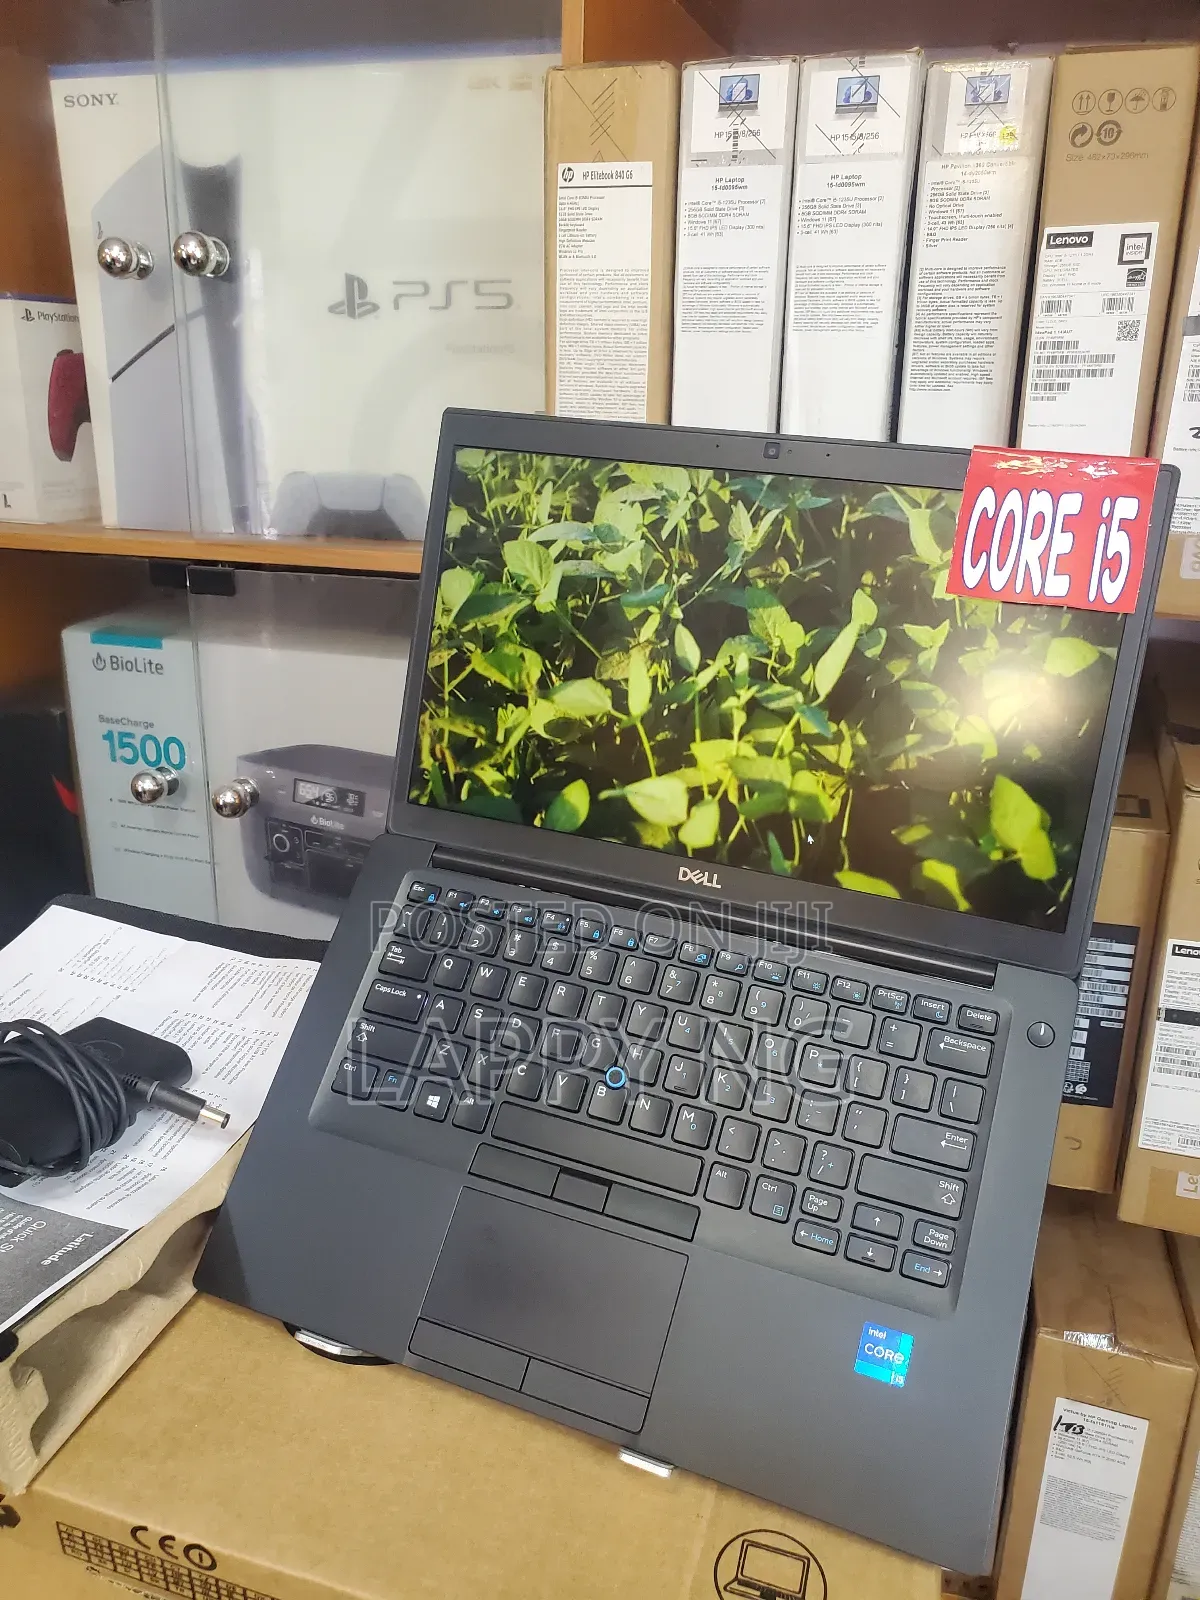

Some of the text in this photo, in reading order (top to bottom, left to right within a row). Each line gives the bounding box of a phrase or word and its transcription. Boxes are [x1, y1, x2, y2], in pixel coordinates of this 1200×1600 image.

[64, 93, 117, 109] SONY
[582, 170, 633, 180] HP Elitebook 840 G6
[1050, 235, 1089, 245] Lenovo
[1126, 242, 1144, 251] intel
[392, 280, 514, 311] PS5
[38, 311, 79, 324] PlayStation
[962, 485, 1140, 605] CORE i5
[110, 655, 164, 676] BioLite
[98, 714, 155, 729] BaseCharge
[101, 729, 186, 771] 1500
[678, 867, 721, 888] DELL
[413, 884, 425, 892] Esc
[448, 891, 457, 899] F1
[480, 898, 490, 906] F2
[546, 913, 555, 921] F4
[580, 920, 589, 928] F5
[613, 928, 623, 936] F6
[648, 936, 658, 944] F7
[390, 945, 403, 954] Tab
[444, 959, 453, 970] Q
[547, 957, 555, 966] 4
[758, 961, 773, 970] F10
[480, 967, 493, 978] W
[585, 966, 593, 975] 5
[798, 970, 810, 979] F11
[519, 976, 527, 987] E
[625, 975, 632, 984] 6
[837, 980, 851, 989] F12
[375, 983, 407, 997] Caps Lock
[557, 986, 566, 996] R
[878, 989, 905, 1000] PrtScr
[436, 999, 445, 1009] A
[598, 995, 606, 1005] T
[707, 995, 715, 1004] 8
[637, 1005, 647, 1015] Y
[750, 1006, 758, 1014] 9
[920, 999, 945, 1011] Insert
[474, 1009, 483, 1018] S
[966, 1010, 992, 1022] Delete
[512, 1018, 521, 1028] D
[678, 1016, 688, 1026] U
[359, 1022, 375, 1032] Shift
[591, 1038, 600, 1048] G
[943, 1035, 987, 1052] Backspace
[478, 1054, 488, 1065] X
[809, 1050, 819, 1059] P
[343, 1063, 357, 1072] Ctrl
[517, 1065, 527, 1076] C
[674, 1061, 684, 1072] J
[387, 1075, 397, 1084] Fn
[558, 1075, 568, 1086] V
[718, 1073, 728, 1083] K
[597, 1086, 607, 1096] B
[464, 1095, 475, 1106] Alt
[640, 1099, 651, 1110] N
[682, 1109, 694, 1122] M
[945, 1132, 969, 1144] Enter
[715, 1169, 728, 1179] Alt
[761, 1182, 778, 1193] Ctrl
[938, 1180, 960, 1193] Shift
[809, 1194, 828, 1207] Page
[808, 1202, 819, 1212] Up
[10, 1221, 46, 1242] Quick
[929, 1228, 949, 1241] Page
[810, 1232, 834, 1246] Home
[924, 1236, 948, 1249] Down
[41, 1233, 94, 1265] Latitude
[914, 1262, 931, 1274] End
[868, 1327, 887, 1339] intel
